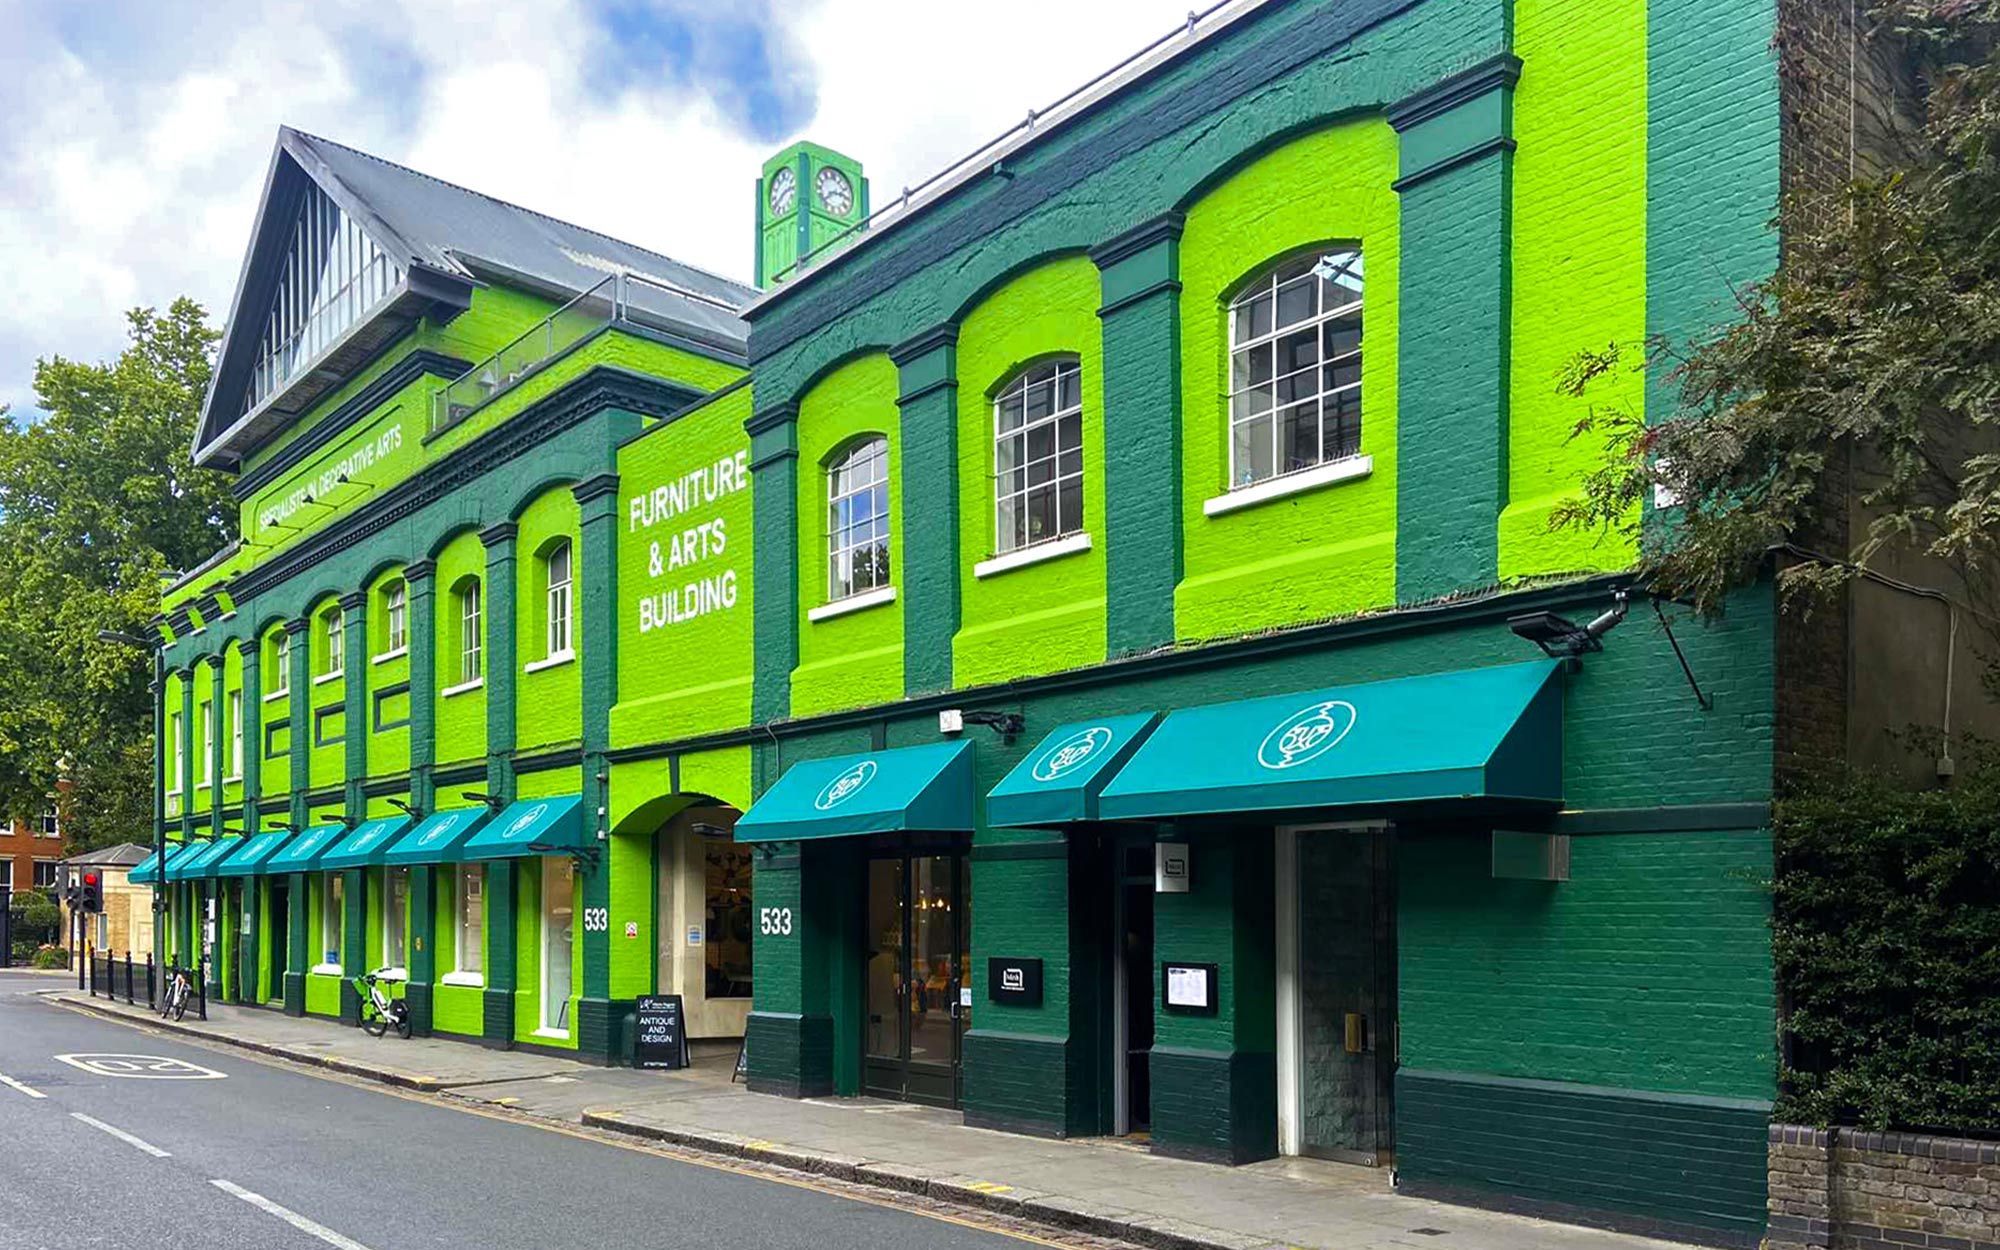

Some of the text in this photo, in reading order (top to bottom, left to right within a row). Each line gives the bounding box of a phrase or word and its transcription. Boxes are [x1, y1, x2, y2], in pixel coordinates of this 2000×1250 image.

[319, 443, 374, 496] DECORATIVE
[376, 424, 402, 460] ARTS
[630, 450, 747, 532] FURNITURE
[649, 517, 726, 578] & ARTS
[640, 569, 736, 633] BUILDING
[584, 908, 608, 931] 533
[760, 908, 792, 935] 533
[639, 1016, 675, 1026] ANTIQUE
[641, 1034, 672, 1042] DESIGN
